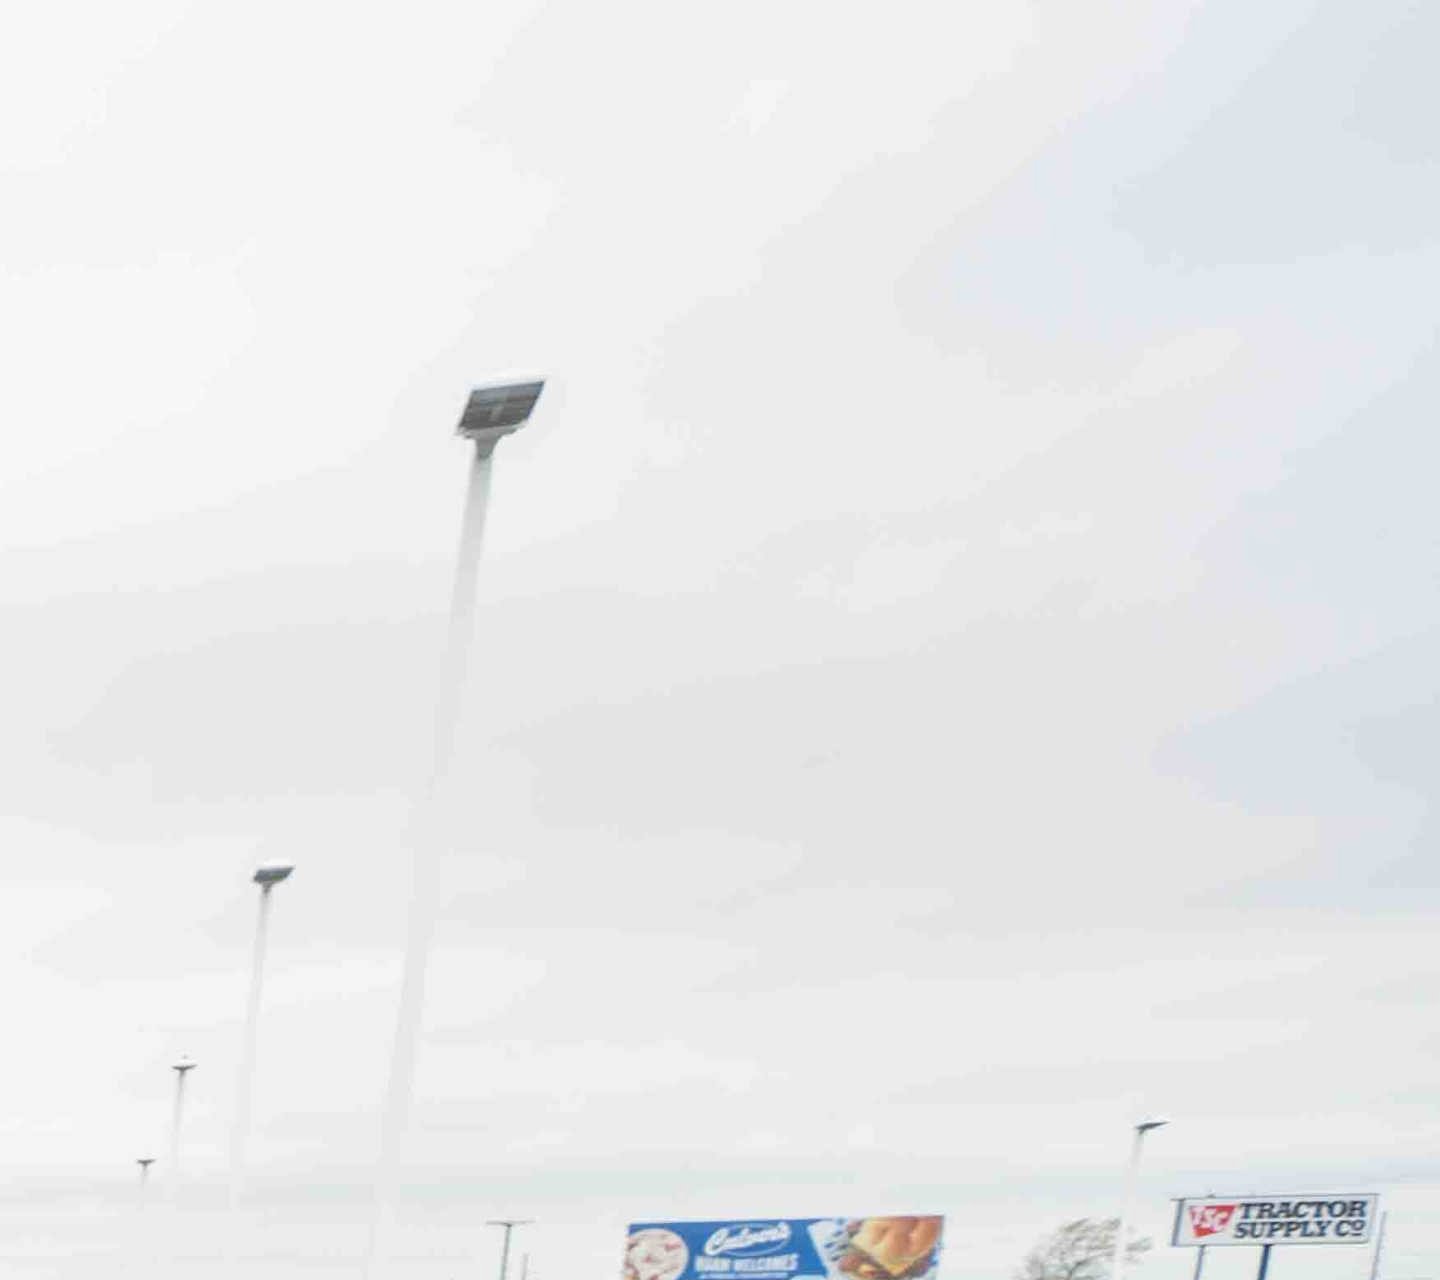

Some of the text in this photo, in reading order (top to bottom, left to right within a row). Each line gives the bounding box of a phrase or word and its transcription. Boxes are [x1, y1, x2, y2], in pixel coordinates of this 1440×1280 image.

[1189, 1206, 1232, 1228] TSC
[1239, 1200, 1368, 1220] TRACTOR
[1233, 1221, 1333, 1239] SUPPLY
